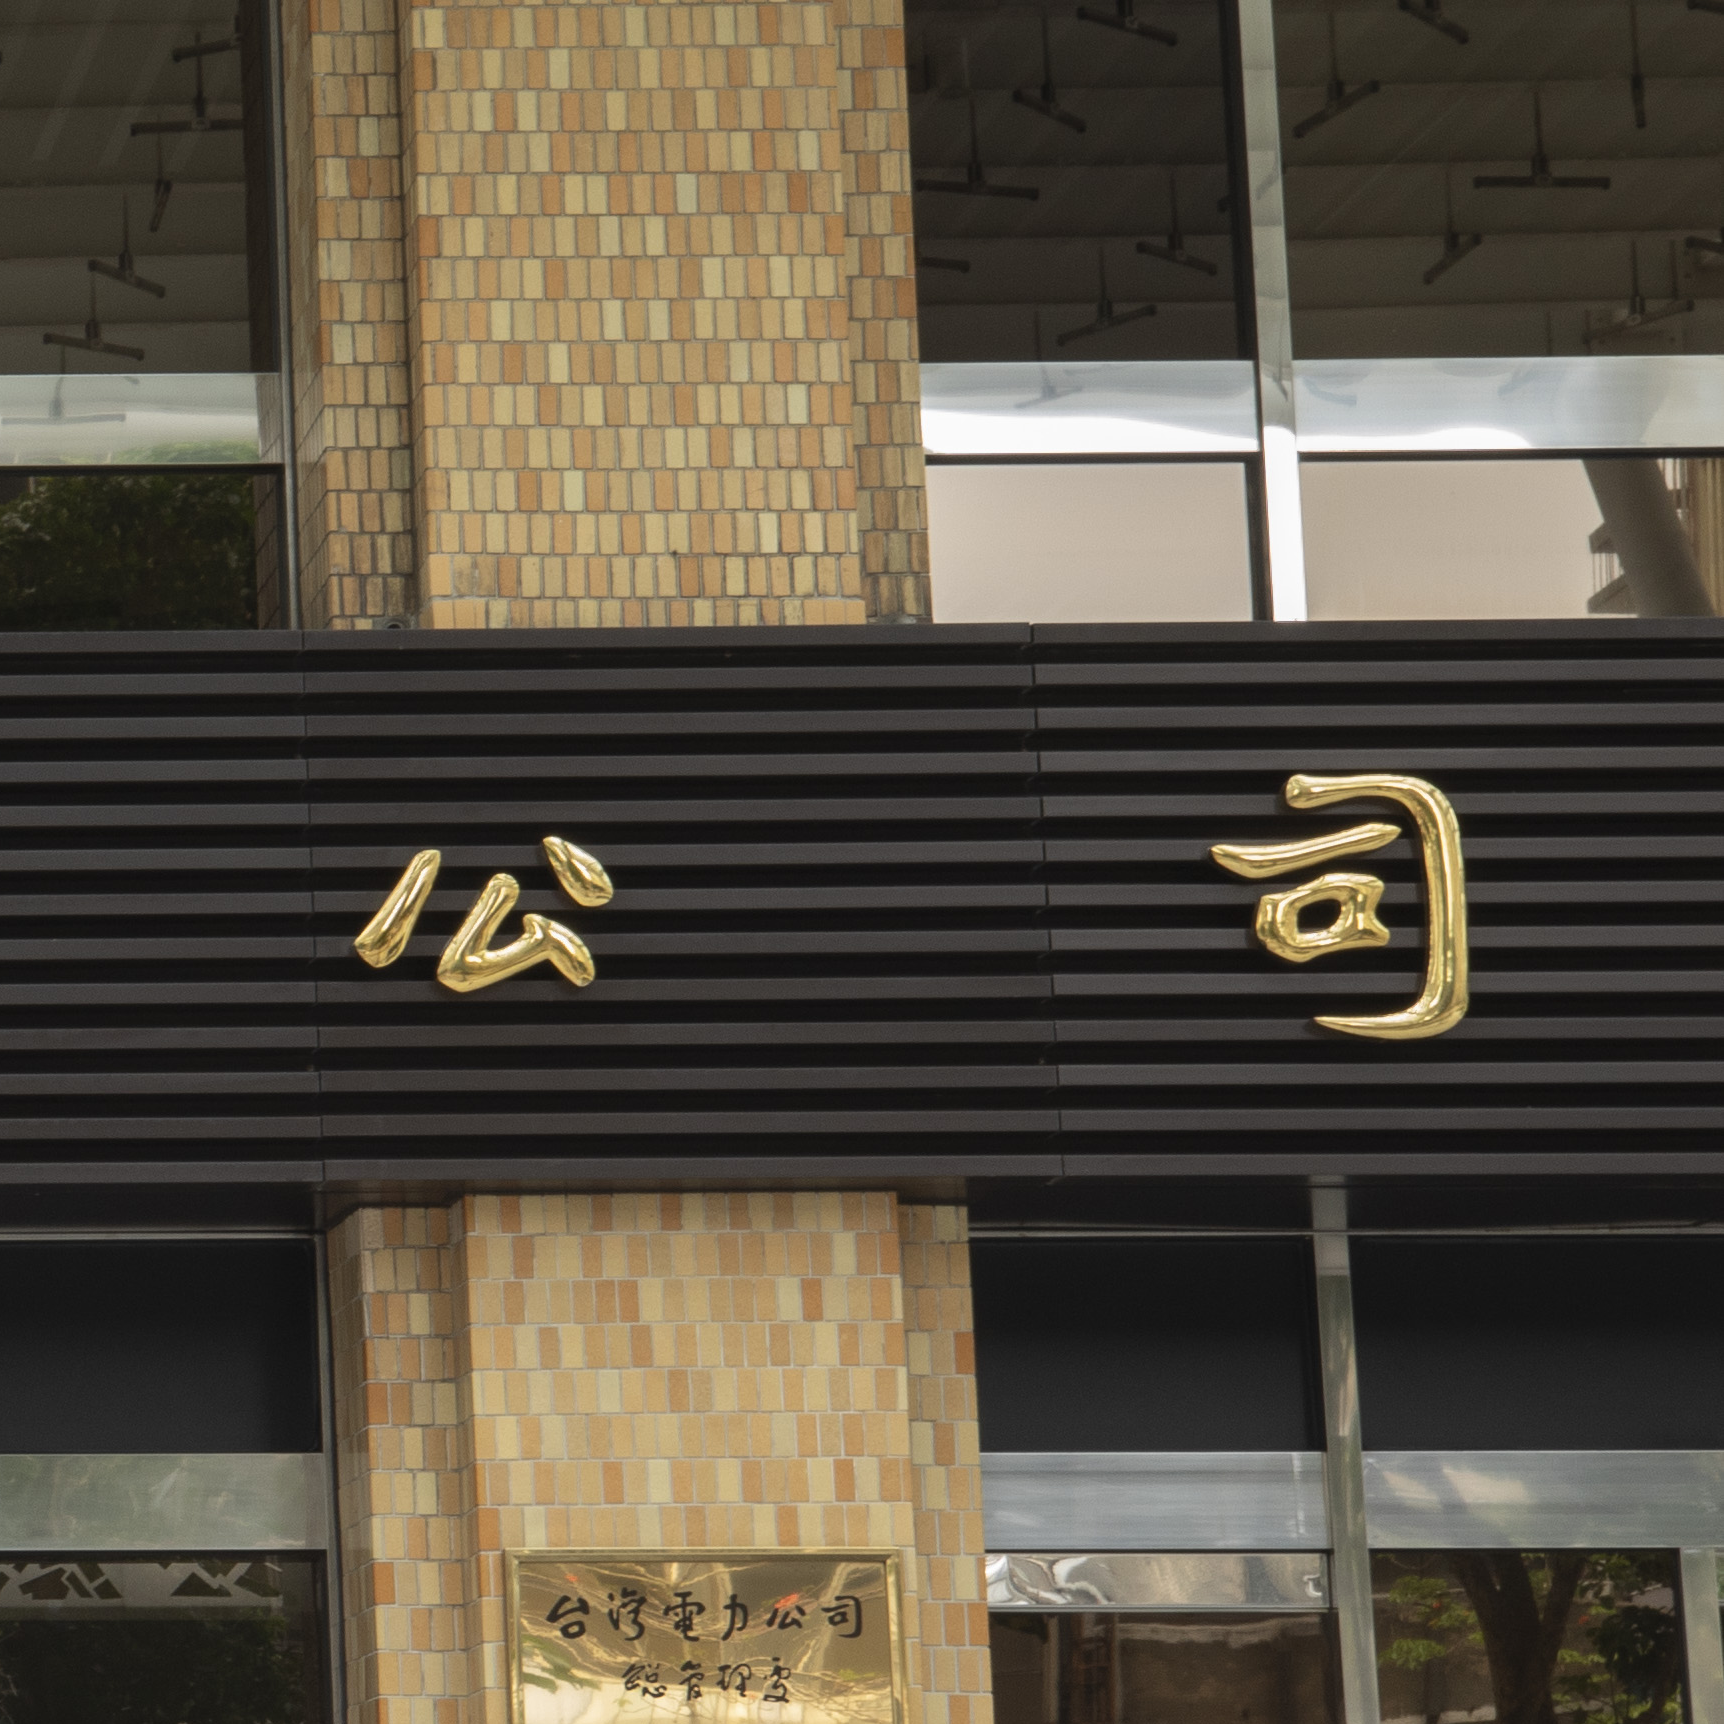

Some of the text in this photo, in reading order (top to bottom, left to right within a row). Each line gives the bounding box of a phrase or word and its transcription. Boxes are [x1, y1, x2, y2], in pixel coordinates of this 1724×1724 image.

[546, 1587, 863, 1642] 台灣電力公司
